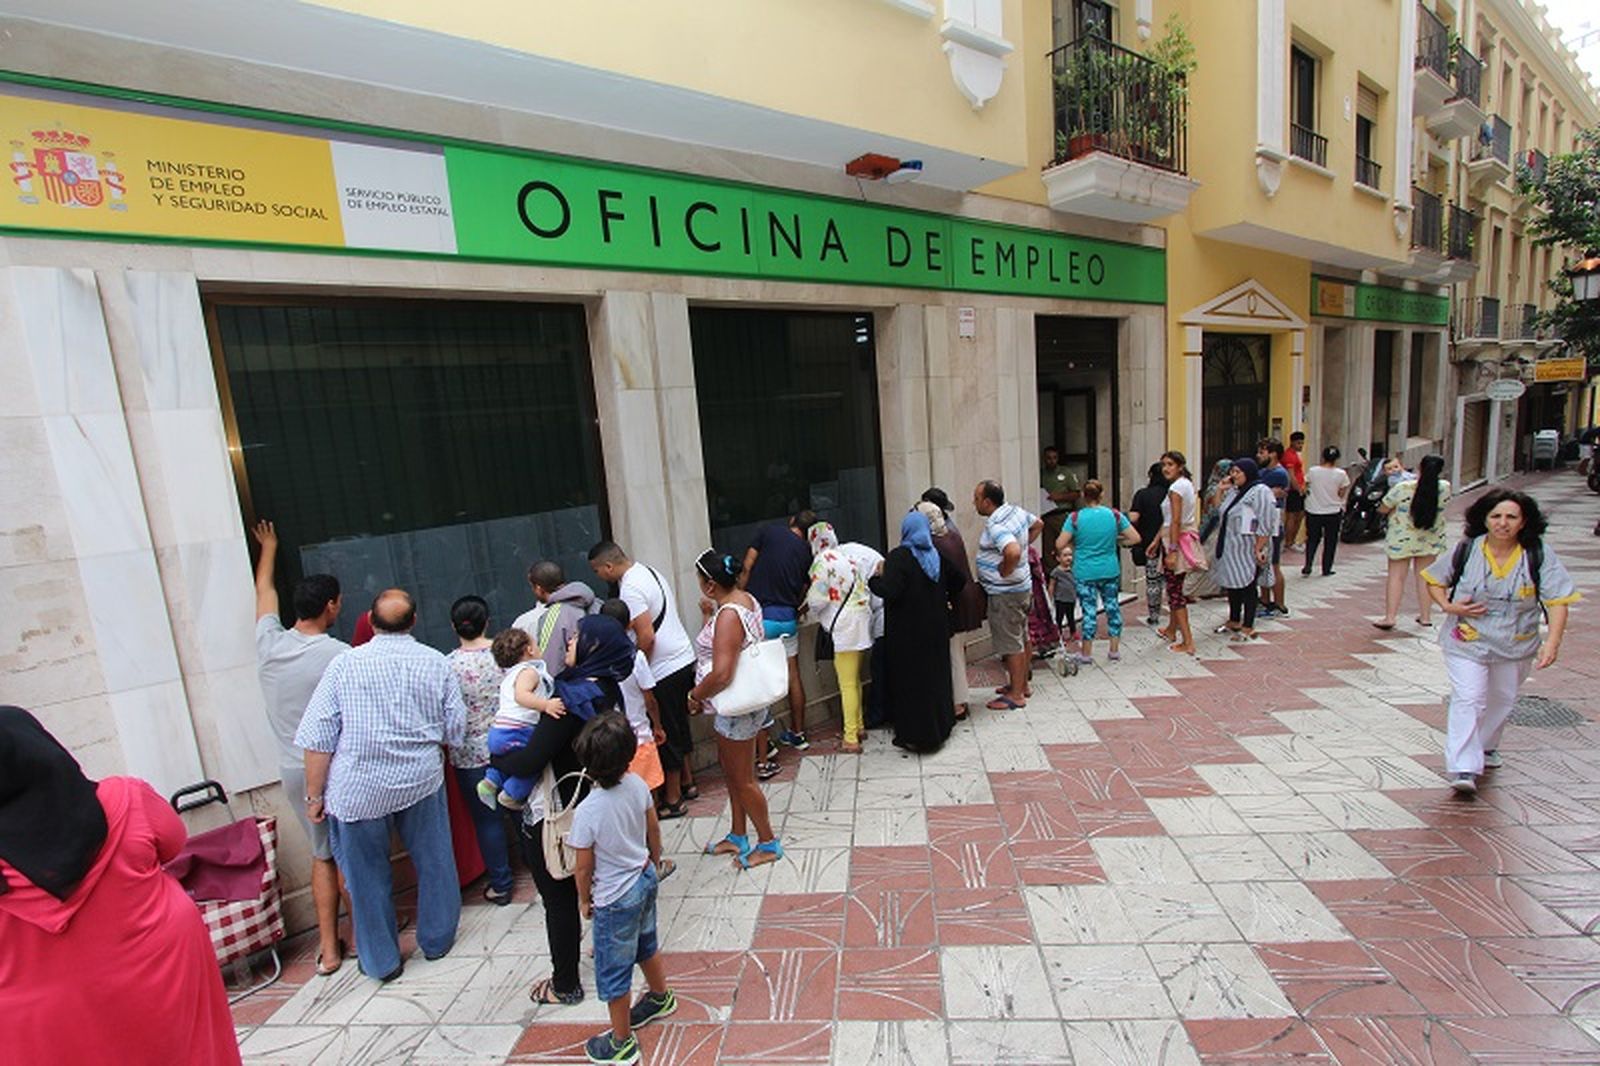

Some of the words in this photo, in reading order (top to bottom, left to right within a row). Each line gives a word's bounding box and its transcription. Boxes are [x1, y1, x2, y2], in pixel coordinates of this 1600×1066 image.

[147, 160, 245, 181] MINISTERIO
[150, 177, 175, 190] DE
[179, 179, 245, 197] EMPLEO
[345, 188, 395, 201] SERVICIO
[152, 194, 164, 206] Y
[171, 195, 267, 215] SEGURIDAD
[271, 203, 328, 220] SOCIAL
[347, 200, 361, 209] DE
[366, 201, 407, 213] EMPLEO
[409, 206, 448, 217] ESTATAL
[517, 180, 848, 263] OFICINA
[887, 226, 942, 271] DE
[971, 238, 1105, 286] EMPLEO
